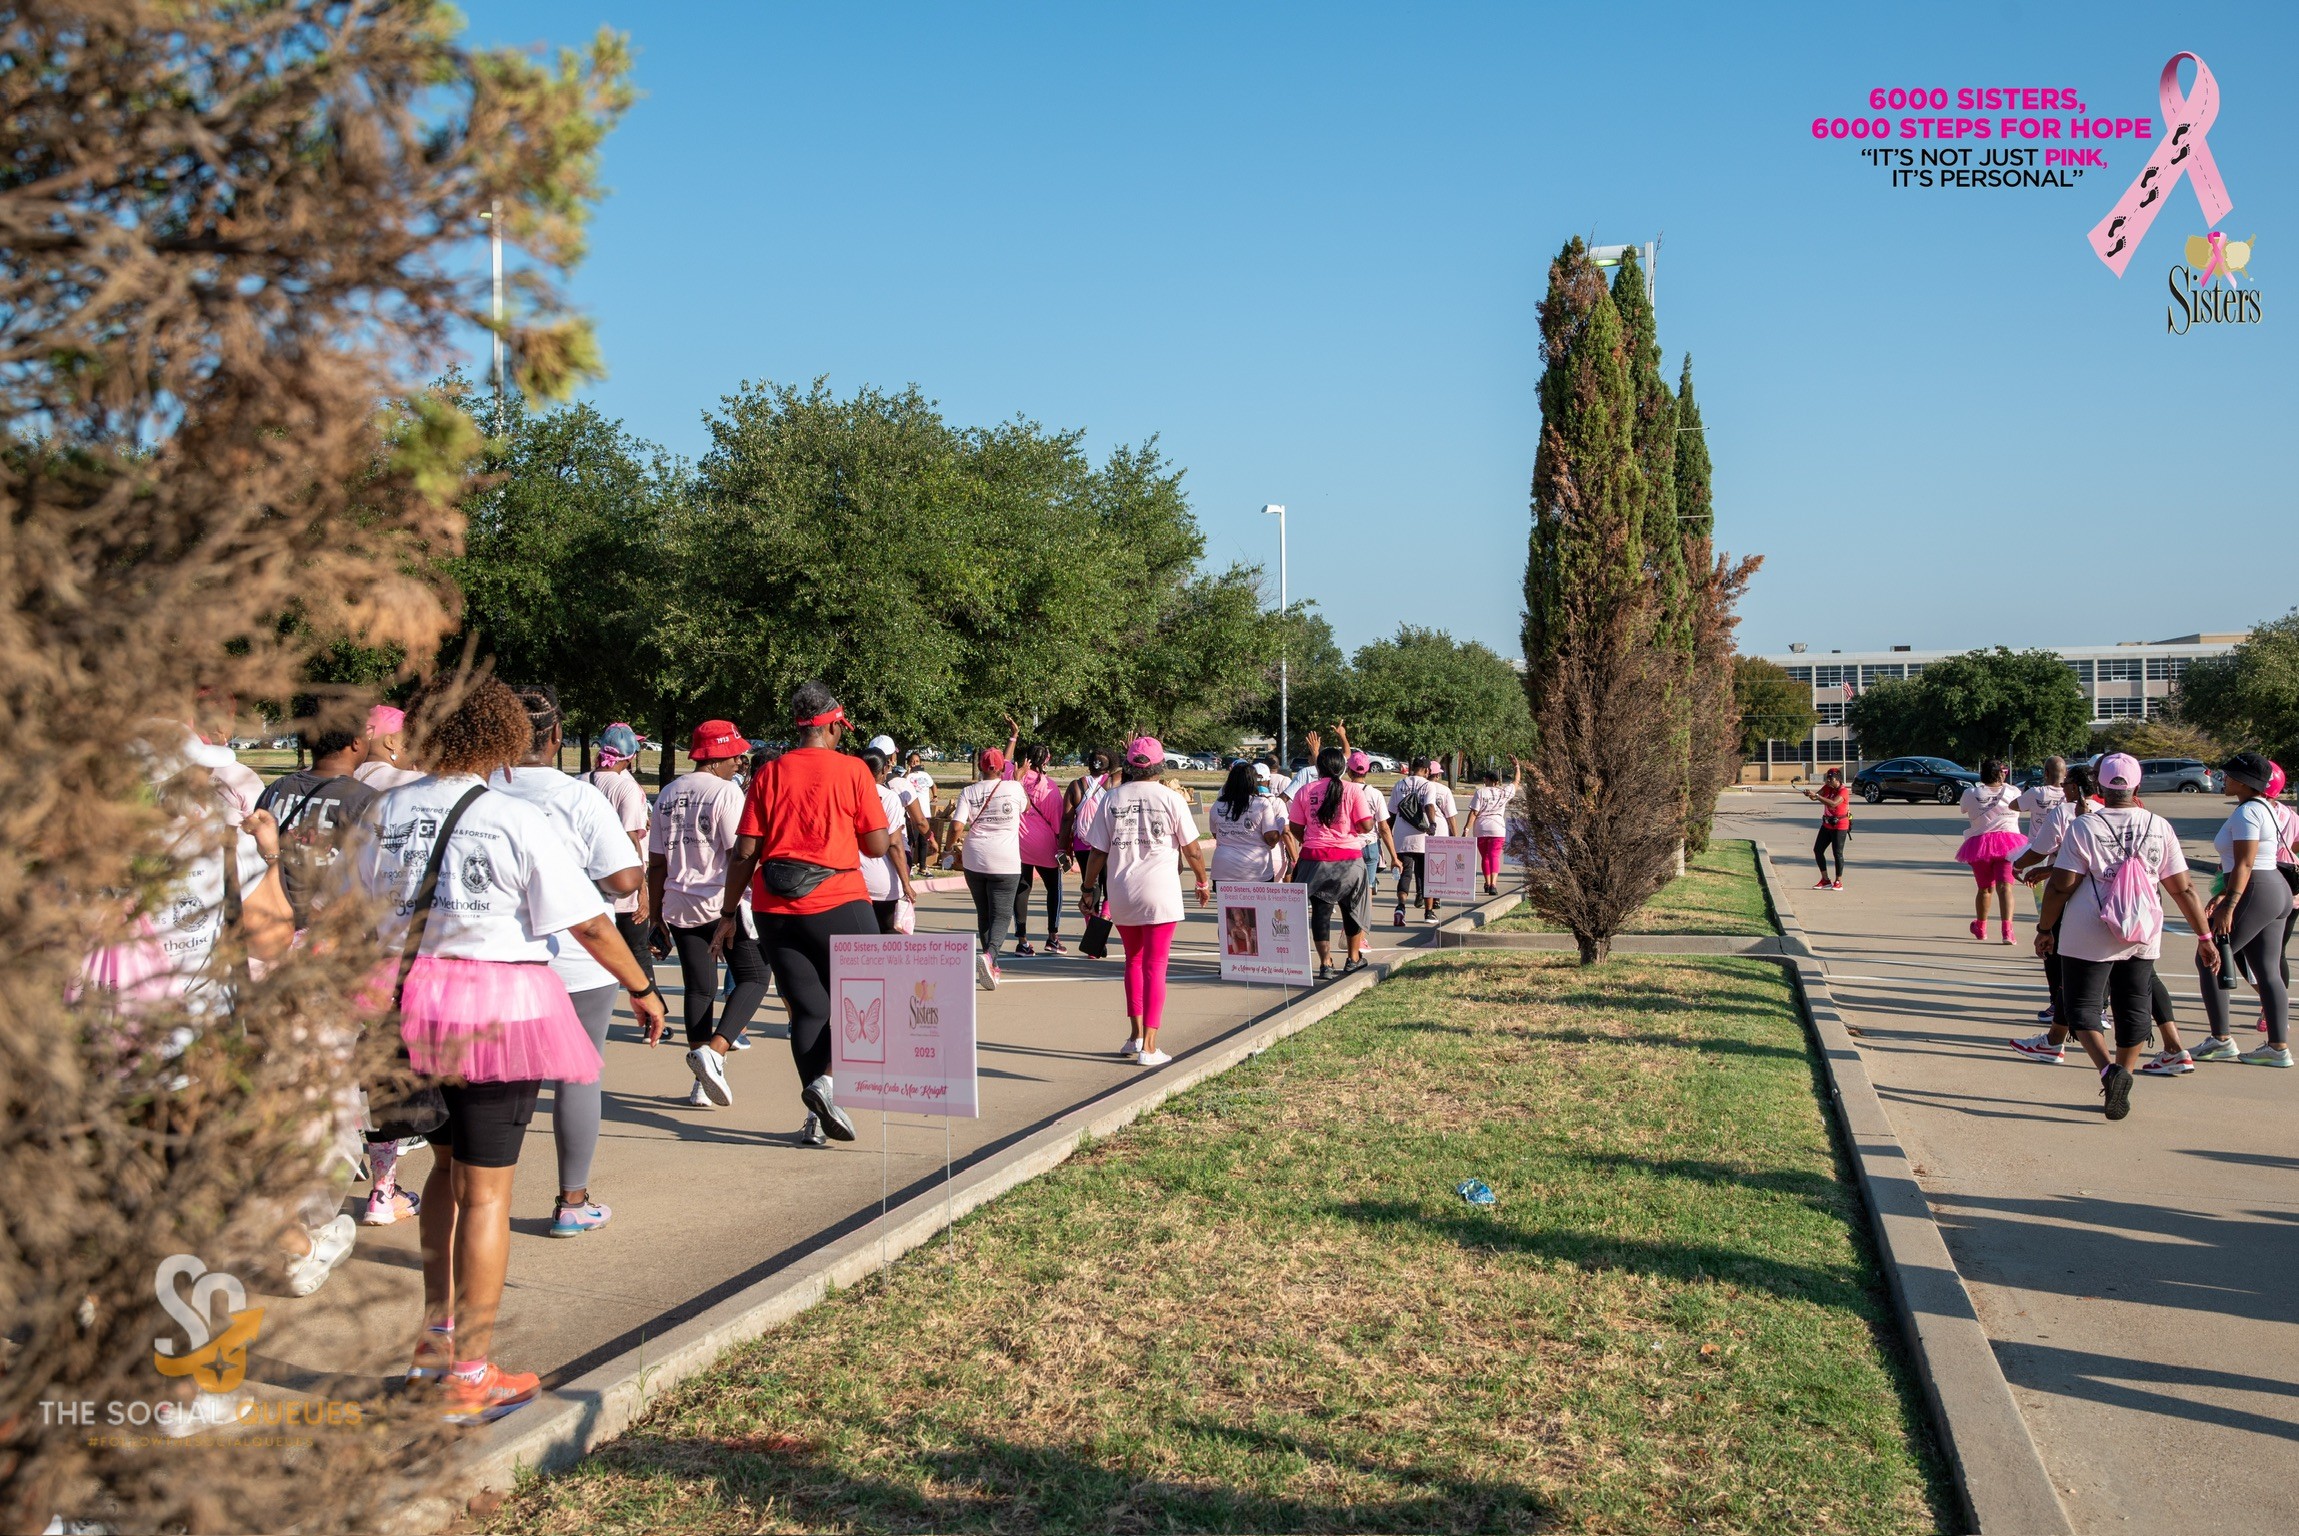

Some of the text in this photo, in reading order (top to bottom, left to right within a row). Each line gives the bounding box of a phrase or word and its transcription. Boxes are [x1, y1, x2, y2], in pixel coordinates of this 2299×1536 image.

[411, 805, 444, 814] Powered
[440, 897, 490, 911] Methodist
[1272, 918, 1290, 937] Sisters
[834, 940, 968, 953] 6000 Sisters, 6000 Steps for Hope
[840, 955, 961, 967] Breast Cancer Walk & Health Expo
[909, 995, 939, 1029] Sisters
[914, 1047, 936, 1058] 2023
[854, 1080, 883, 1094] Honoring
[901, 1083, 918, 1099] Mae
[919, 1084, 948, 1099] Knight
